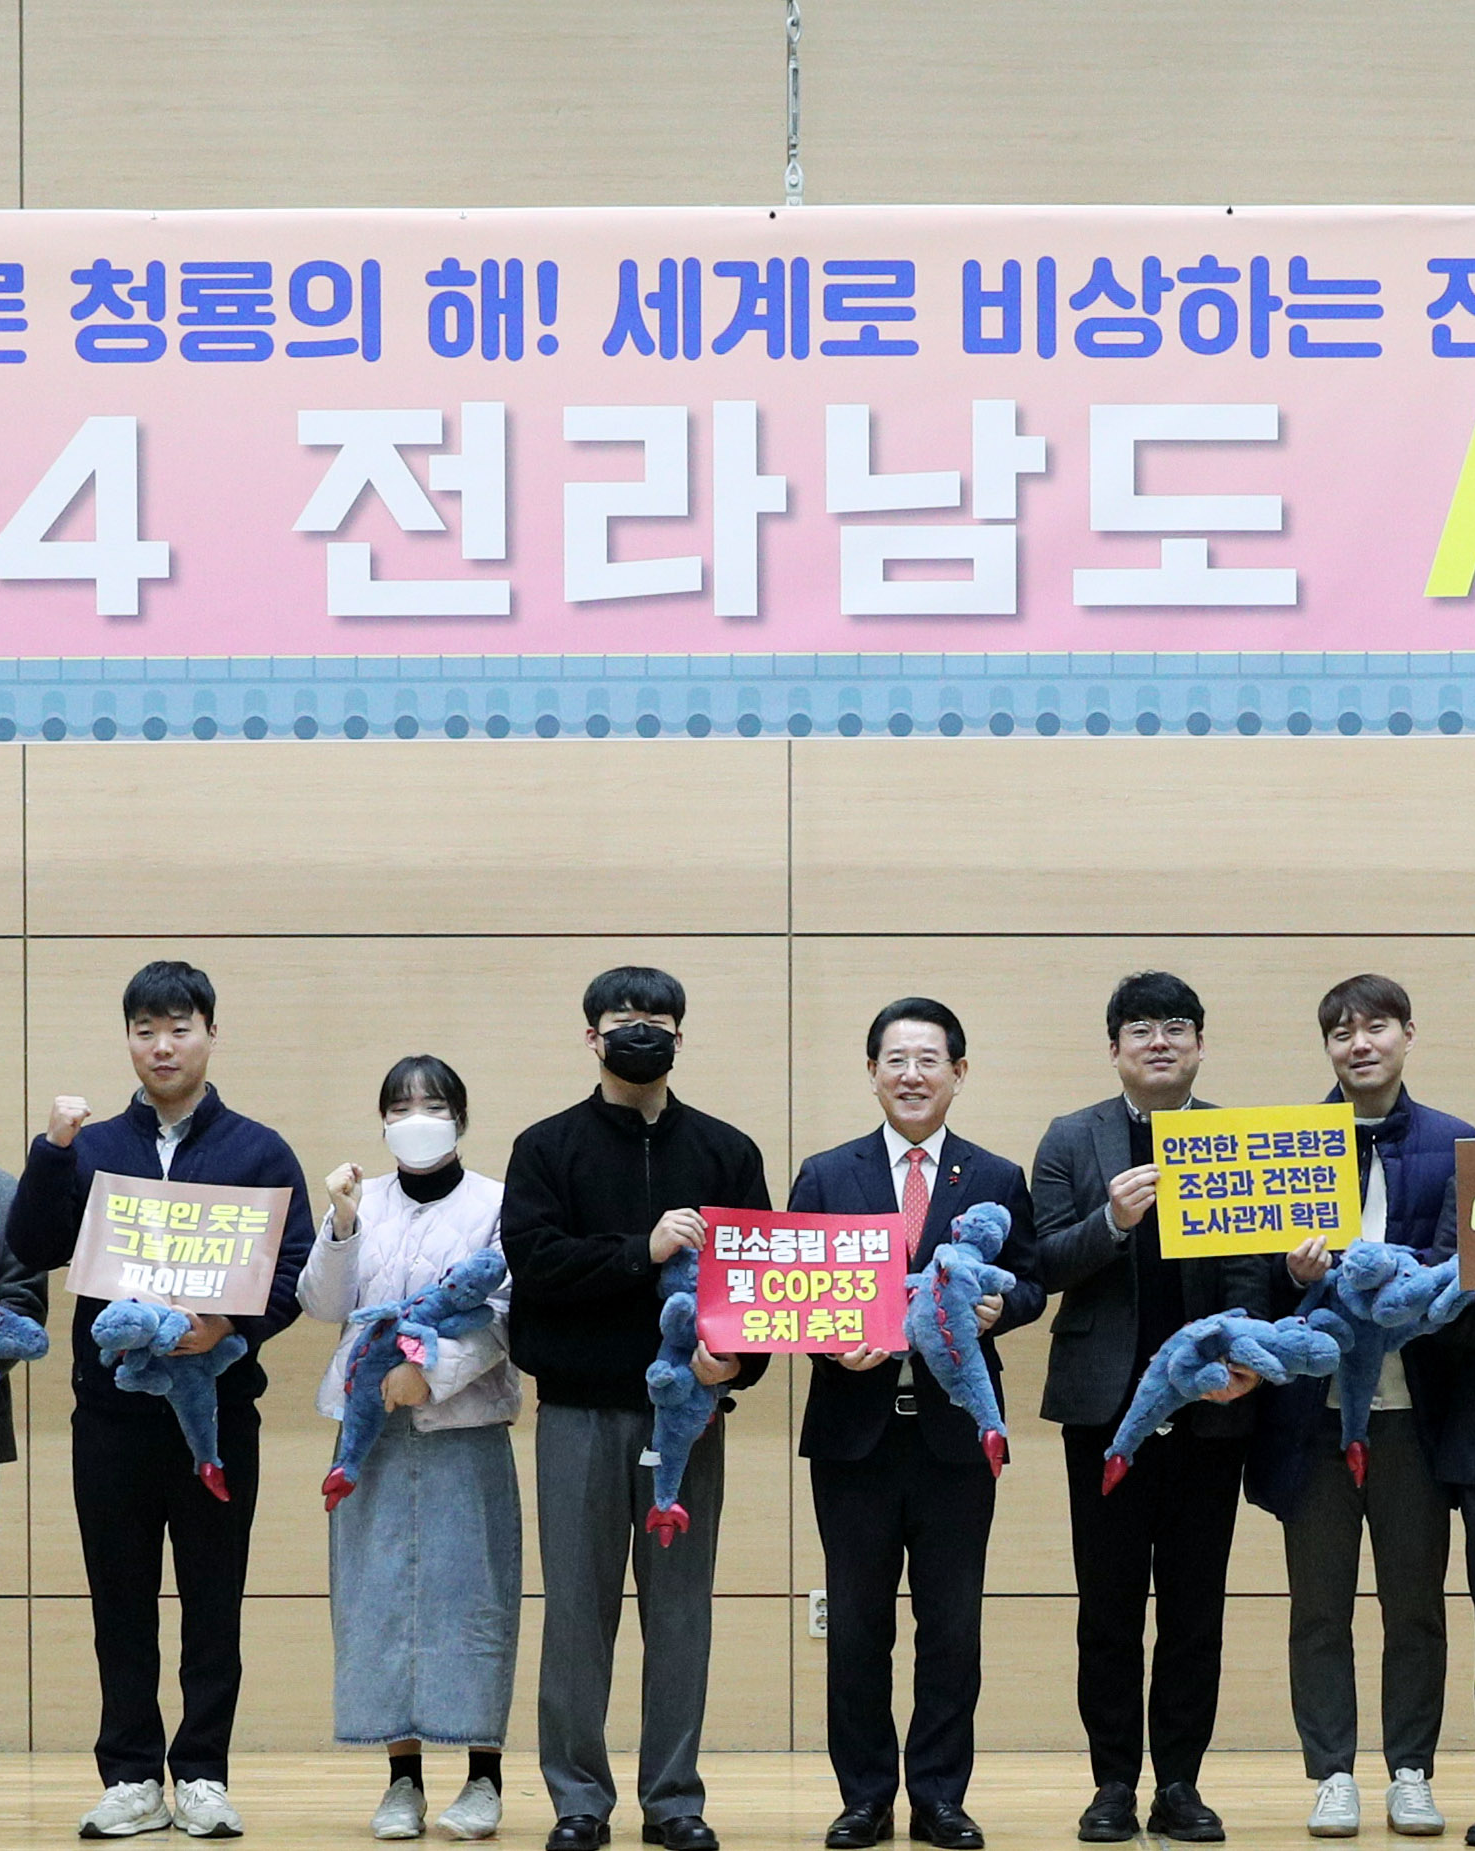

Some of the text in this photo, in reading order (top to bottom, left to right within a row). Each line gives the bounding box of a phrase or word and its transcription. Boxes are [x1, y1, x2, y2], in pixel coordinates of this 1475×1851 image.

[70, 257, 383, 363] 청룡의
[425, 257, 559, 362] 해!
[602, 256, 920, 361] 세계로
[962, 254, 1385, 360] 비상하는
[291, 400, 1298, 617] 전라남도
[1162, 1129, 1347, 1165] 안전한 근로환경
[1179, 1165, 1337, 1200] 조성과 건전한
[106, 1193, 270, 1233] 민원인 웃는
[1182, 1201, 1340, 1236] 노사관계 확립
[714, 1225, 890, 1264] 탄소중립 실현
[117, 1261, 228, 1298] 파이팅!
[727, 1269, 878, 1304] 및 COP33
[741, 1308, 864, 1342] 유치 추진
